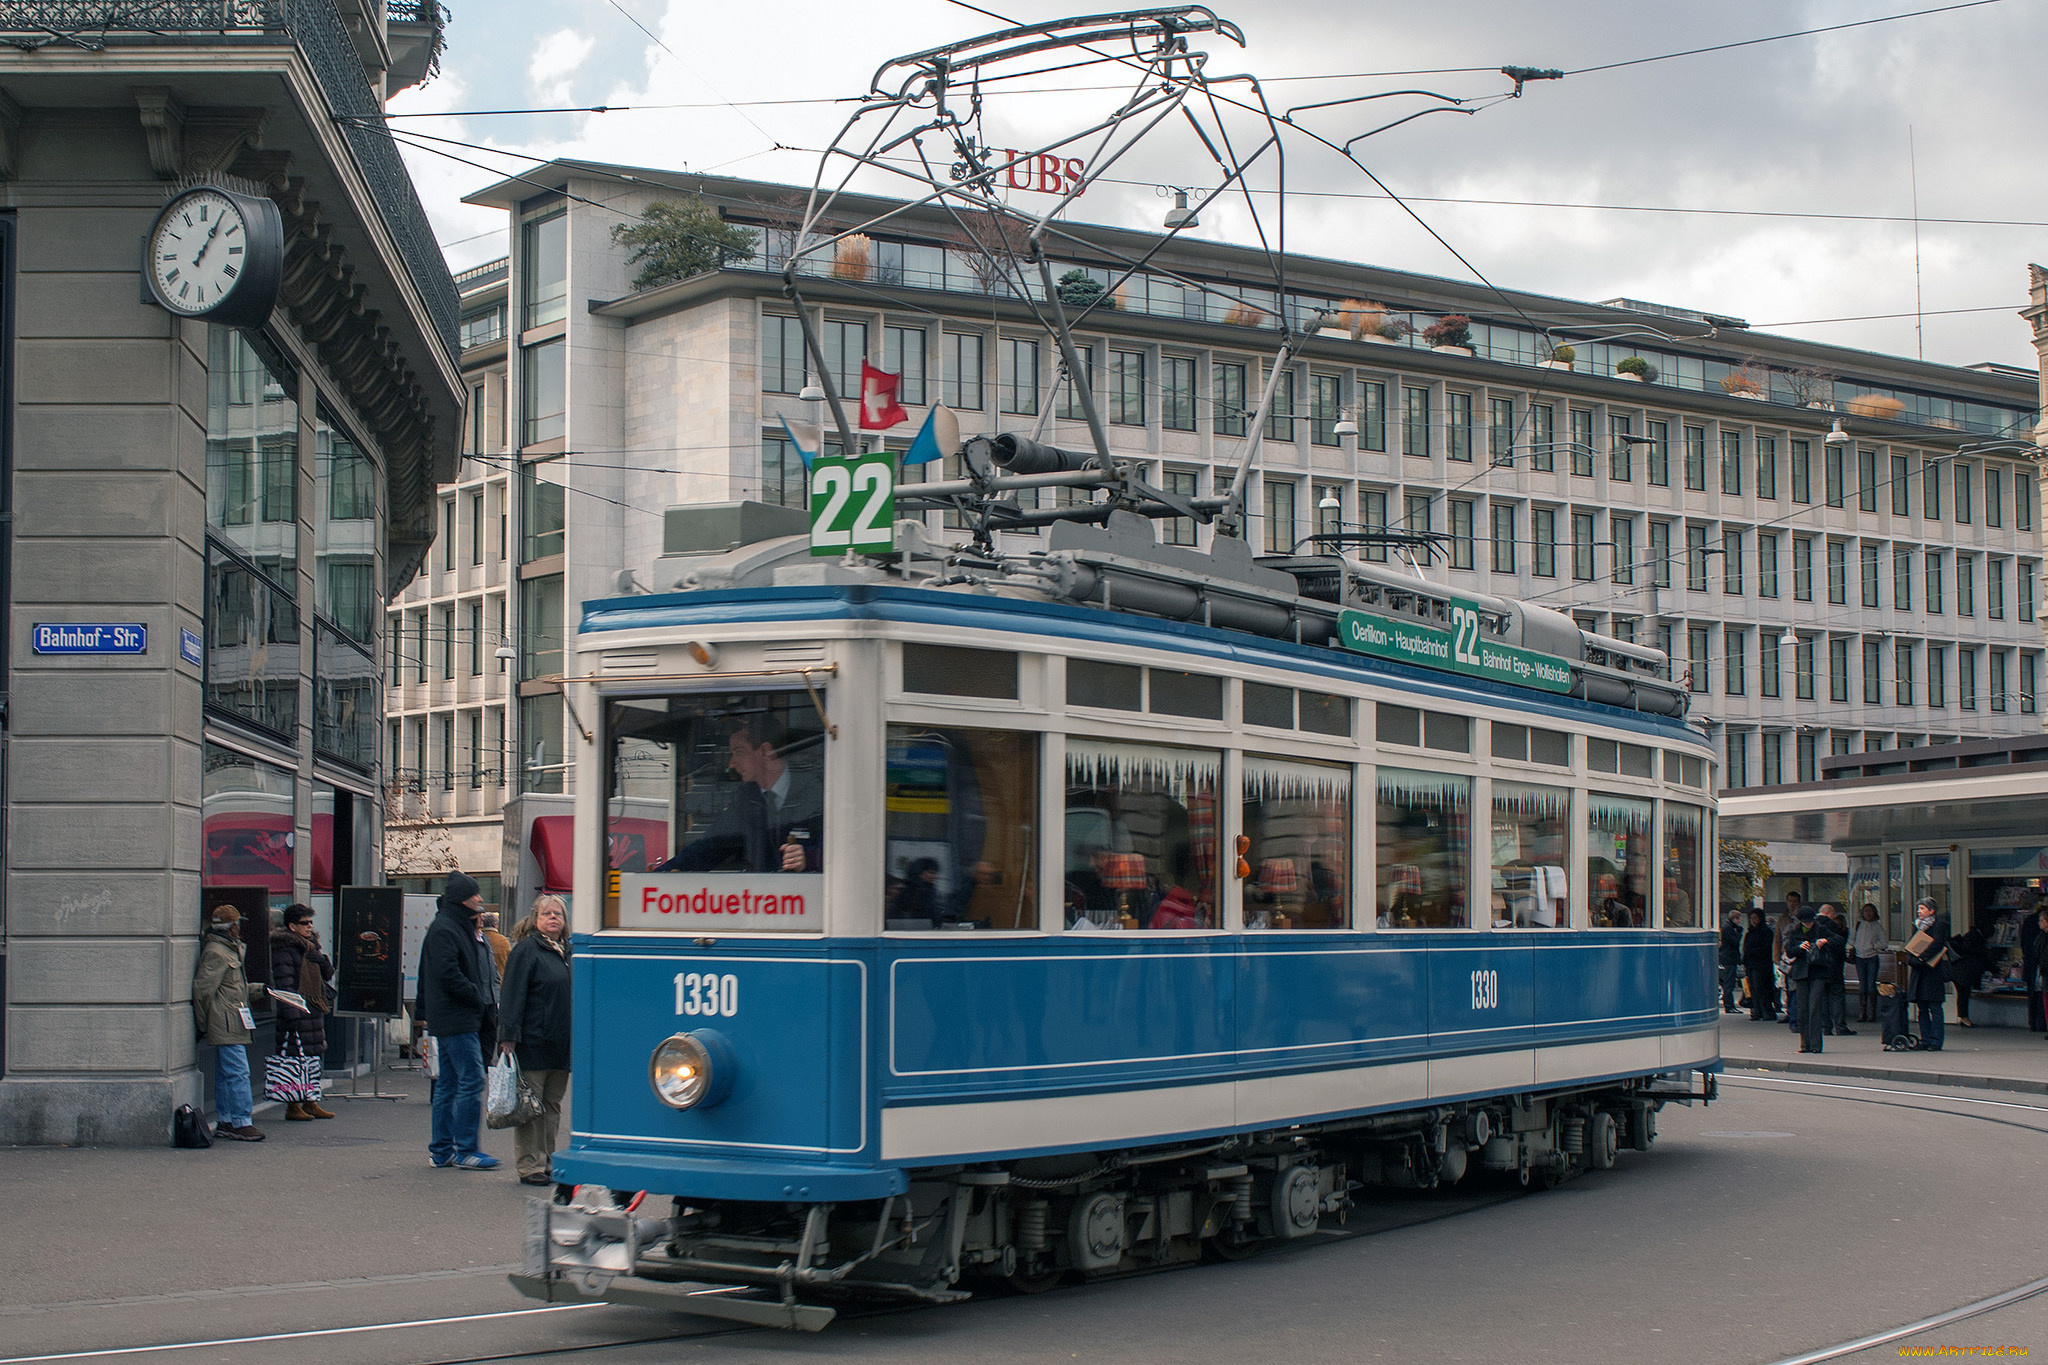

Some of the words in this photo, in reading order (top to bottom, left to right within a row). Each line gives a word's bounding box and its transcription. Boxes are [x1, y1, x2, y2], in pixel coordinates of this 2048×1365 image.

[1005, 148, 1087, 197] UBS
[811, 462, 892, 547] 22
[1352, 620, 1388, 646] Oerlikon
[1395, 630, 1449, 659] Hauptbahnhof
[1452, 606, 1481, 666] 22
[1482, 649, 1512, 672] Bahnhof
[641, 886, 806, 915] Fonduetram
[673, 972, 739, 1018] 1330
[1470, 969, 1498, 1010] 1330
